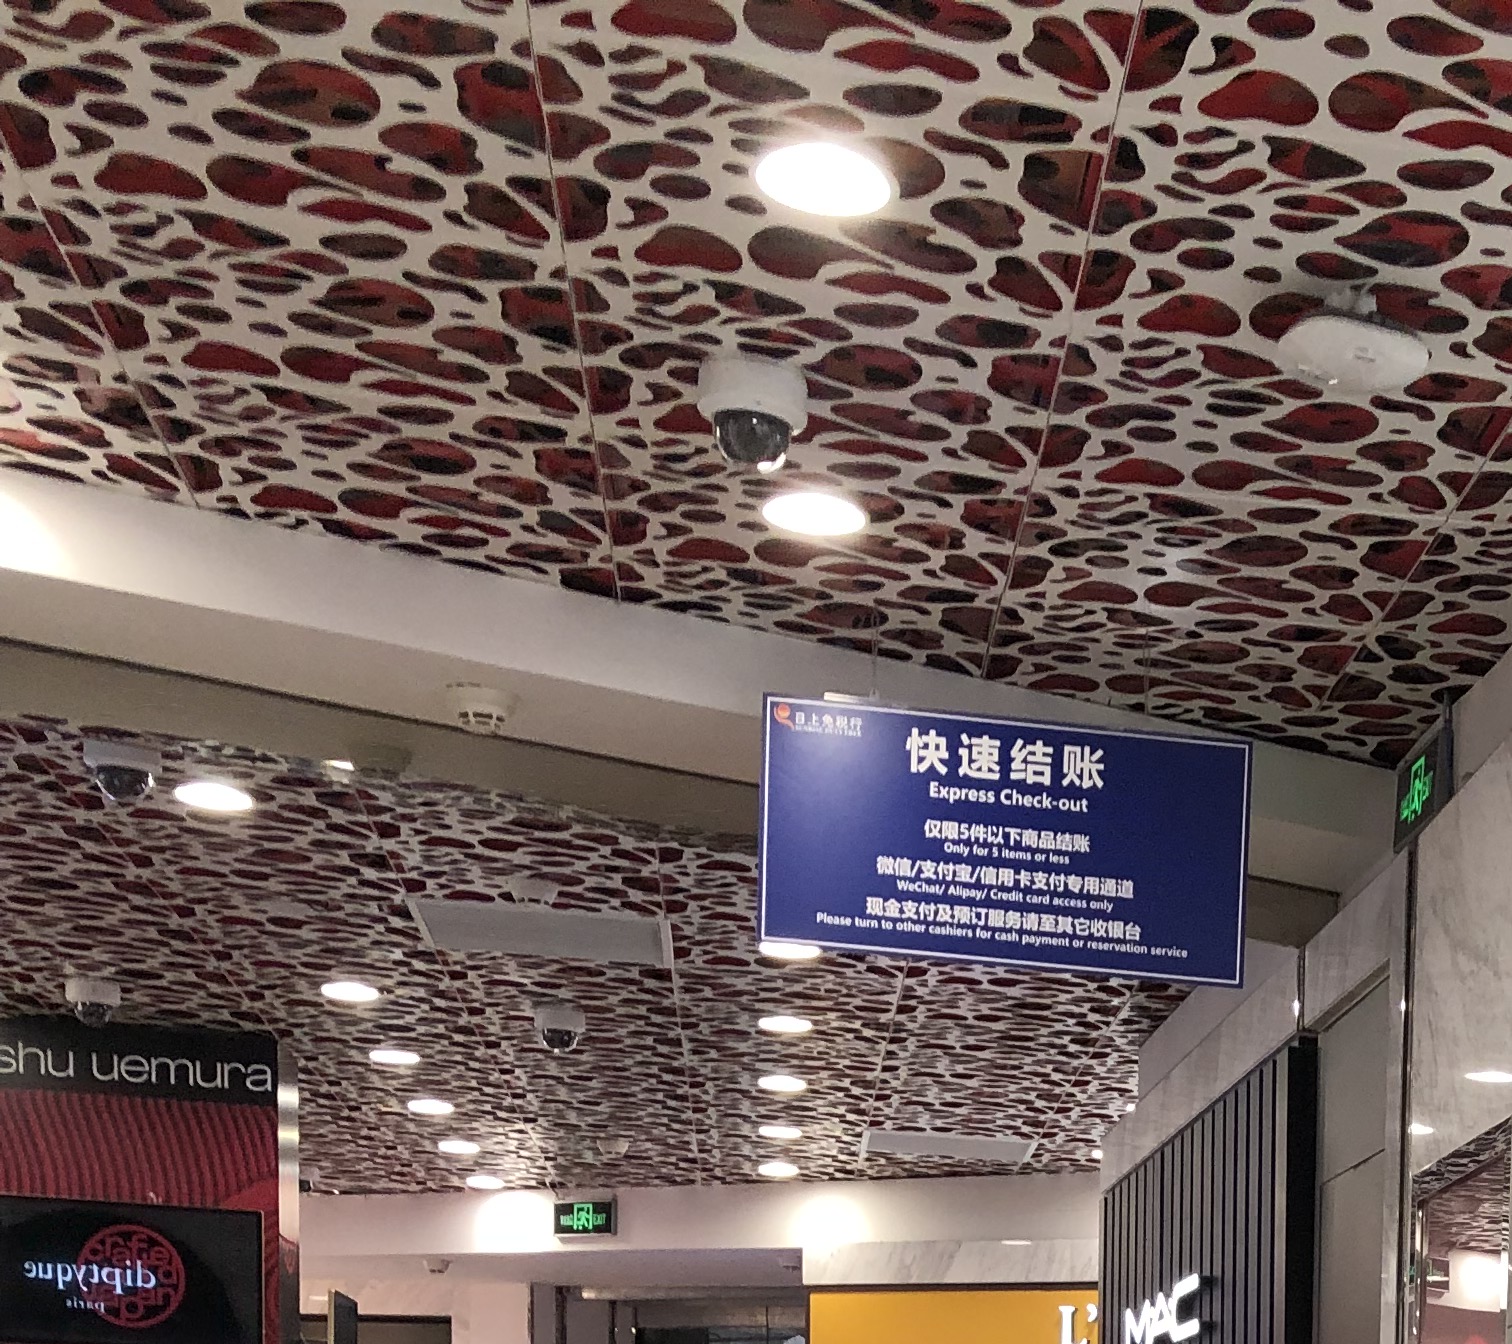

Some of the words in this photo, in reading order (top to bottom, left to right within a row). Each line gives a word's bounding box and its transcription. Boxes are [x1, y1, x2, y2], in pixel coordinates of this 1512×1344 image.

[906, 727, 1104, 790] 快速结账
[929, 781, 996, 804] Express
[1000, 788, 1089, 813] Check-out
[924, 818, 1091, 853] 仅限5件以下商品结账
[943, 842, 970, 858] Only
[972, 845, 989, 857] for
[991, 846, 999, 857] 5
[1001, 847, 1032, 861] items
[1034, 852, 1047, 863] or
[1049, 852, 1070, 865] less
[876, 855, 1134, 899] 微信/支付宝/信用卡支付专用通道
[896, 878, 946, 896] WeChat/
[947, 881, 988, 901] Alipay/
[990, 888, 1023, 903] Credit
[1026, 893, 1050, 906] card
[1052, 897, 1087, 910] access
[1090, 899, 1113, 914] only
[816, 911, 852, 926] Please
[855, 916, 879, 929] turn
[881, 919, 894, 930] to
[896, 920, 926, 934] other
[928, 924, 973, 938] cashiers
[976, 927, 992, 940] for
[994, 930, 1019, 942] cash
[1022, 931, 1070, 948] payment
[1072, 938, 1085, 948] or
[1087, 940, 1148, 955] reservation
[1150, 944, 1188, 959] service
[865, 896, 1142, 942] 现金支付及预订服务请至其它收银台
[0, 1041, 75, 1078] shu
[90, 1051, 273, 1092] uemura
